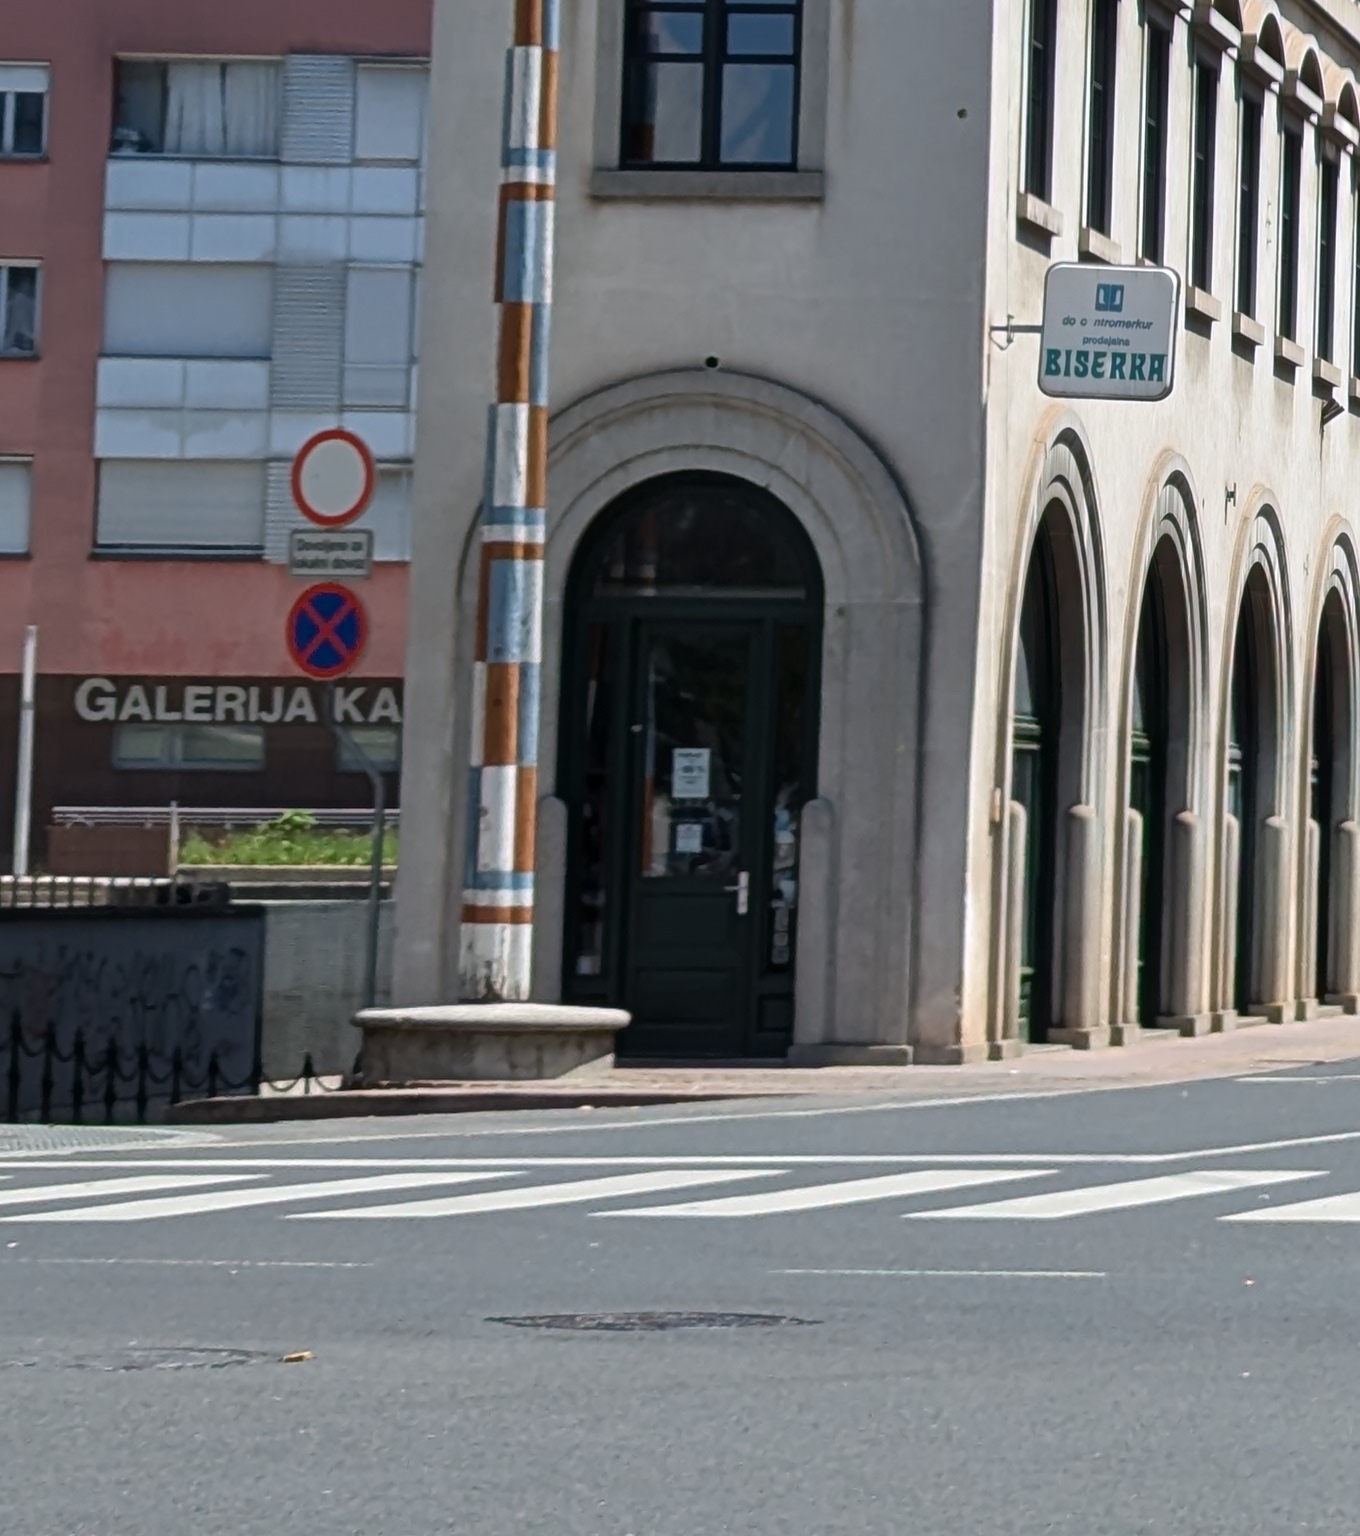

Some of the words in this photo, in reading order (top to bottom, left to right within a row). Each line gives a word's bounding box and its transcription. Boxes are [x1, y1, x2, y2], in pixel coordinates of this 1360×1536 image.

[1082, 335, 1130, 347] prodajalna
[1045, 348, 1167, 382] BISERKA
[74, 678, 318, 721] GALERIJA
